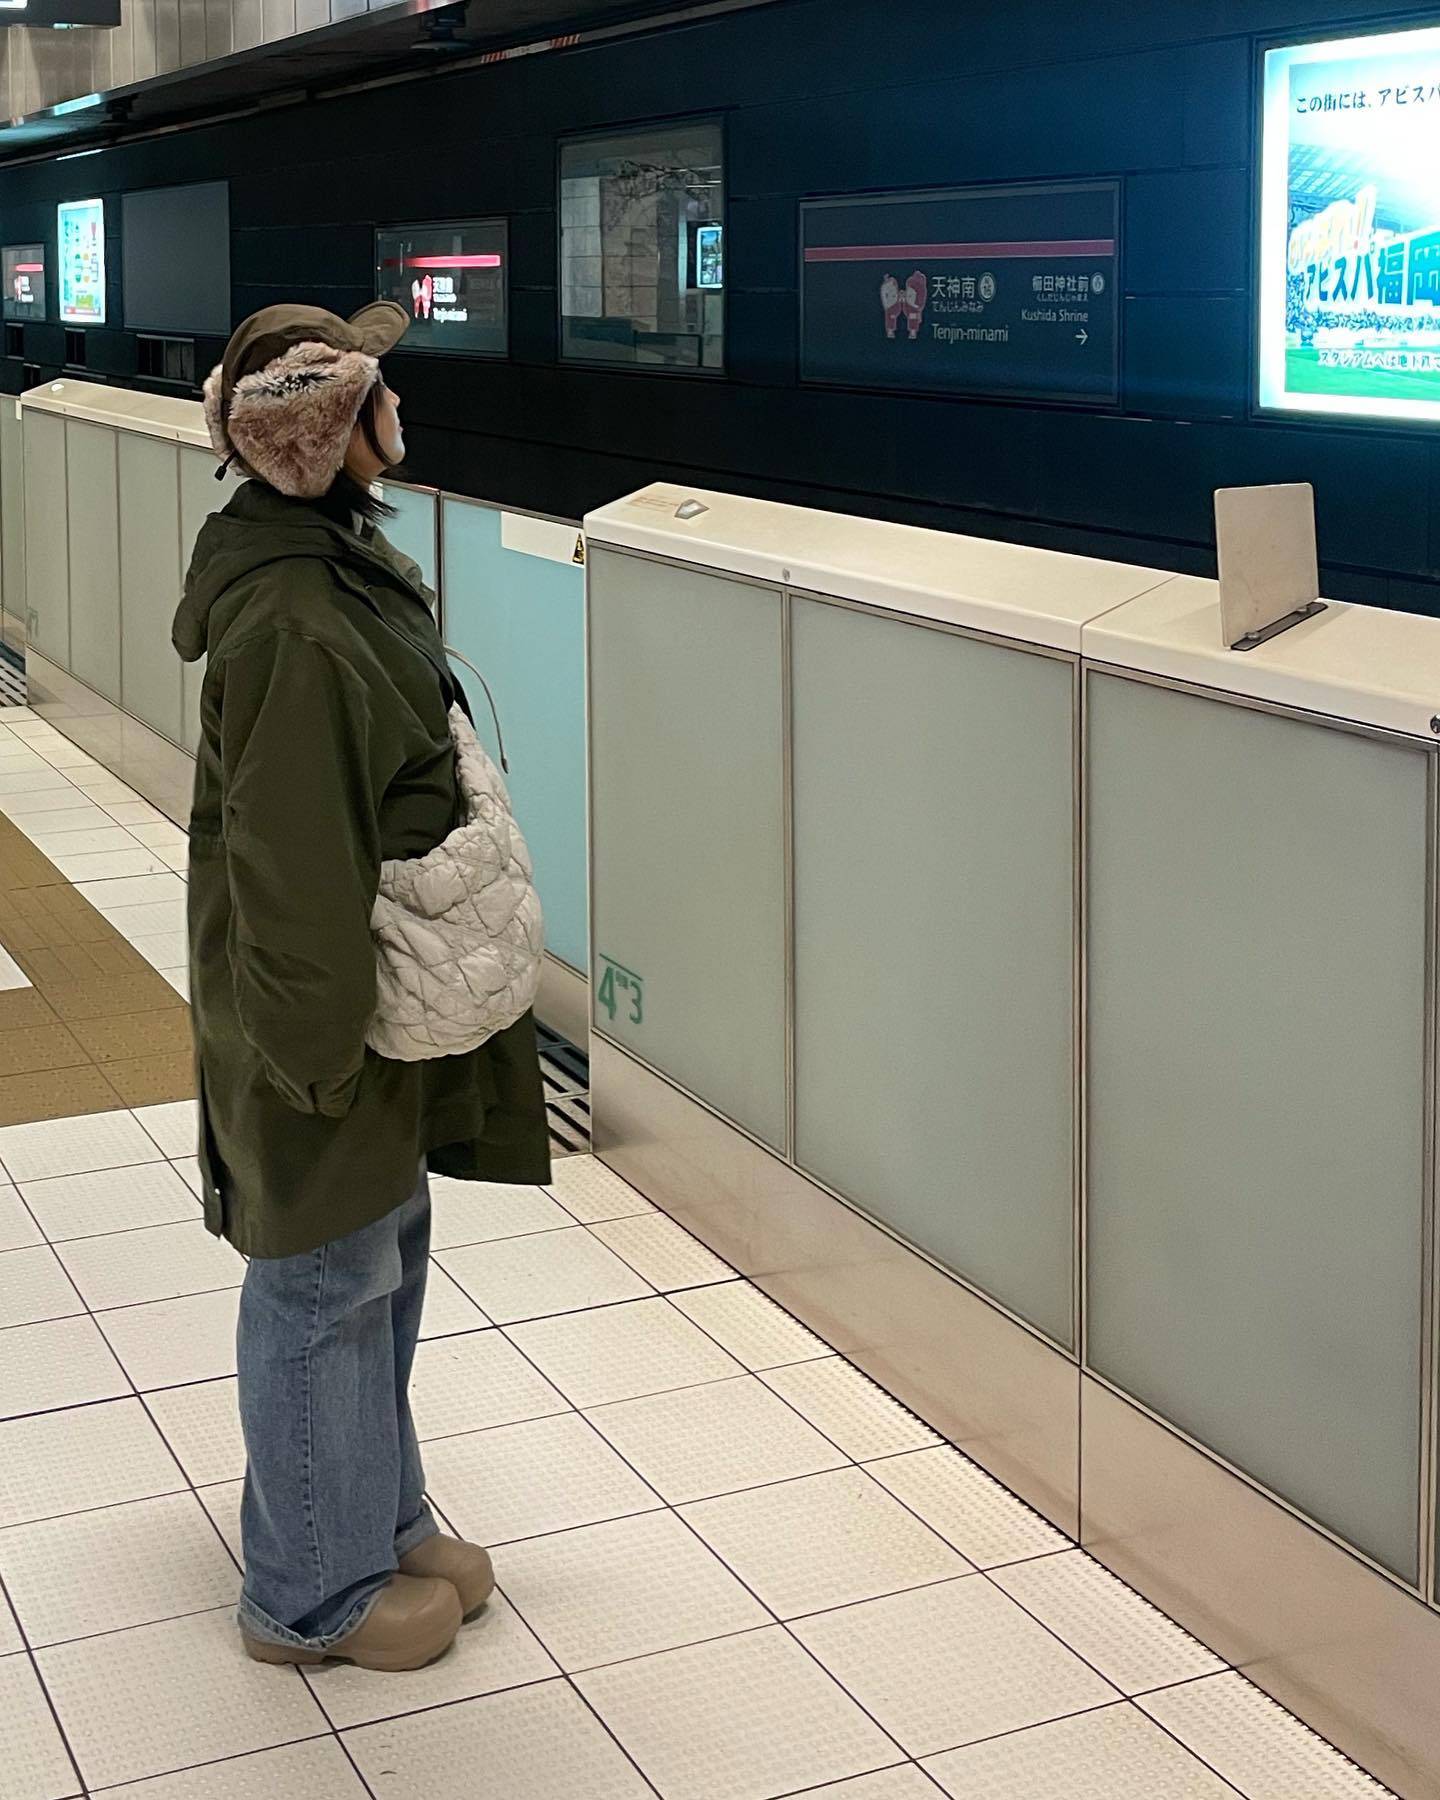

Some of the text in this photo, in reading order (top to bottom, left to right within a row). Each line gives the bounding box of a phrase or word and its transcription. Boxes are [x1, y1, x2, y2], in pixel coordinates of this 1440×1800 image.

[931, 276, 976, 298] 天神南
[1021, 309, 1088, 322] Kushida Shrine
[931, 323, 1008, 344] Tenjin-minami
